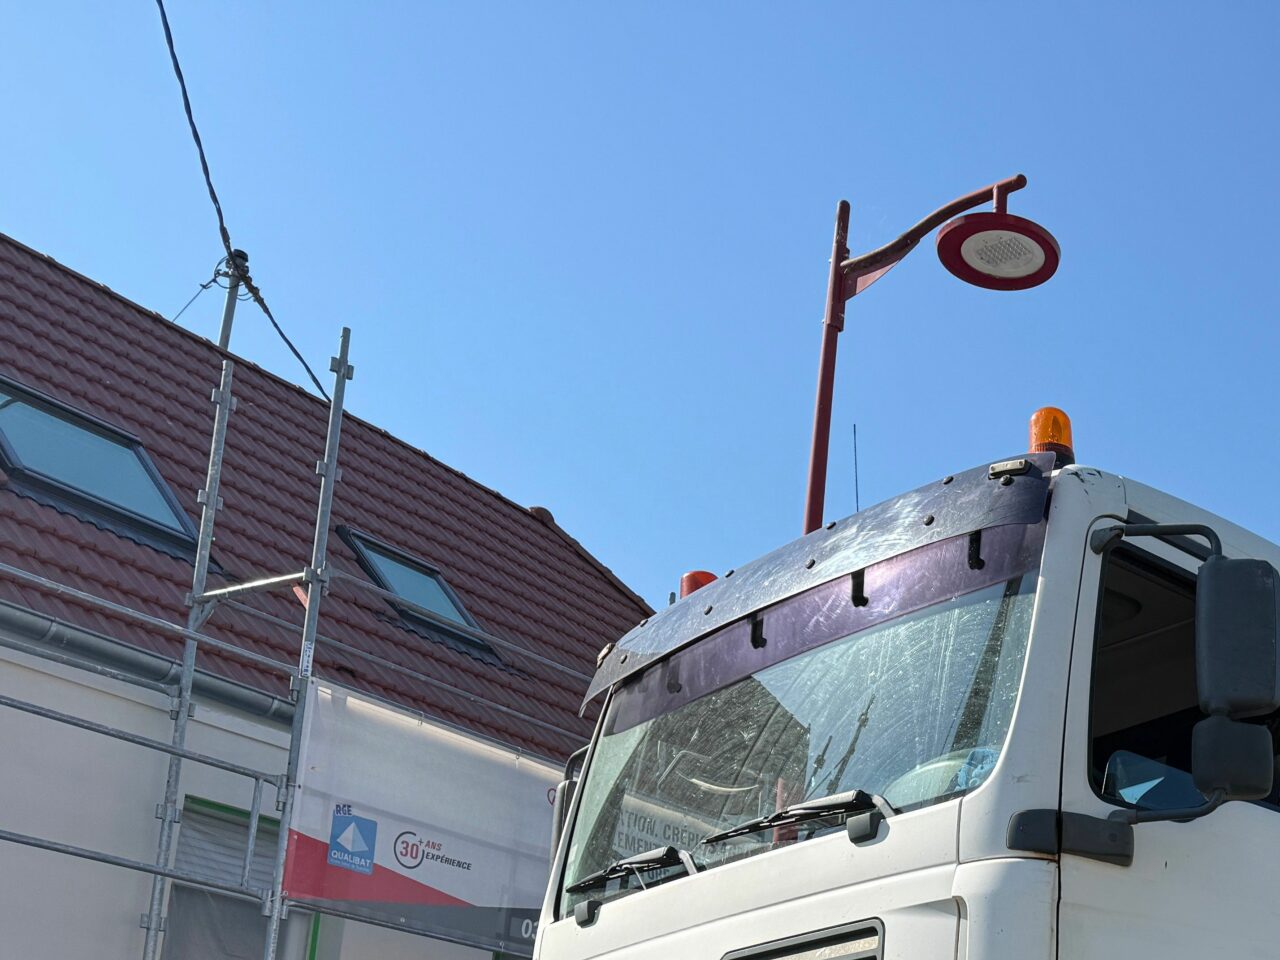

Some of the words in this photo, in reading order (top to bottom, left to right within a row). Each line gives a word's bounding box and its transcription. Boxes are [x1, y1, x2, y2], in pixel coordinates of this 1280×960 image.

[335, 804, 353, 816] RGE
[331, 849, 372, 869] QUALIBAT
[400, 840, 420, 861] 30
[424, 839, 443, 852] ANS
[425, 851, 472, 871] EXPÉRIENCE
